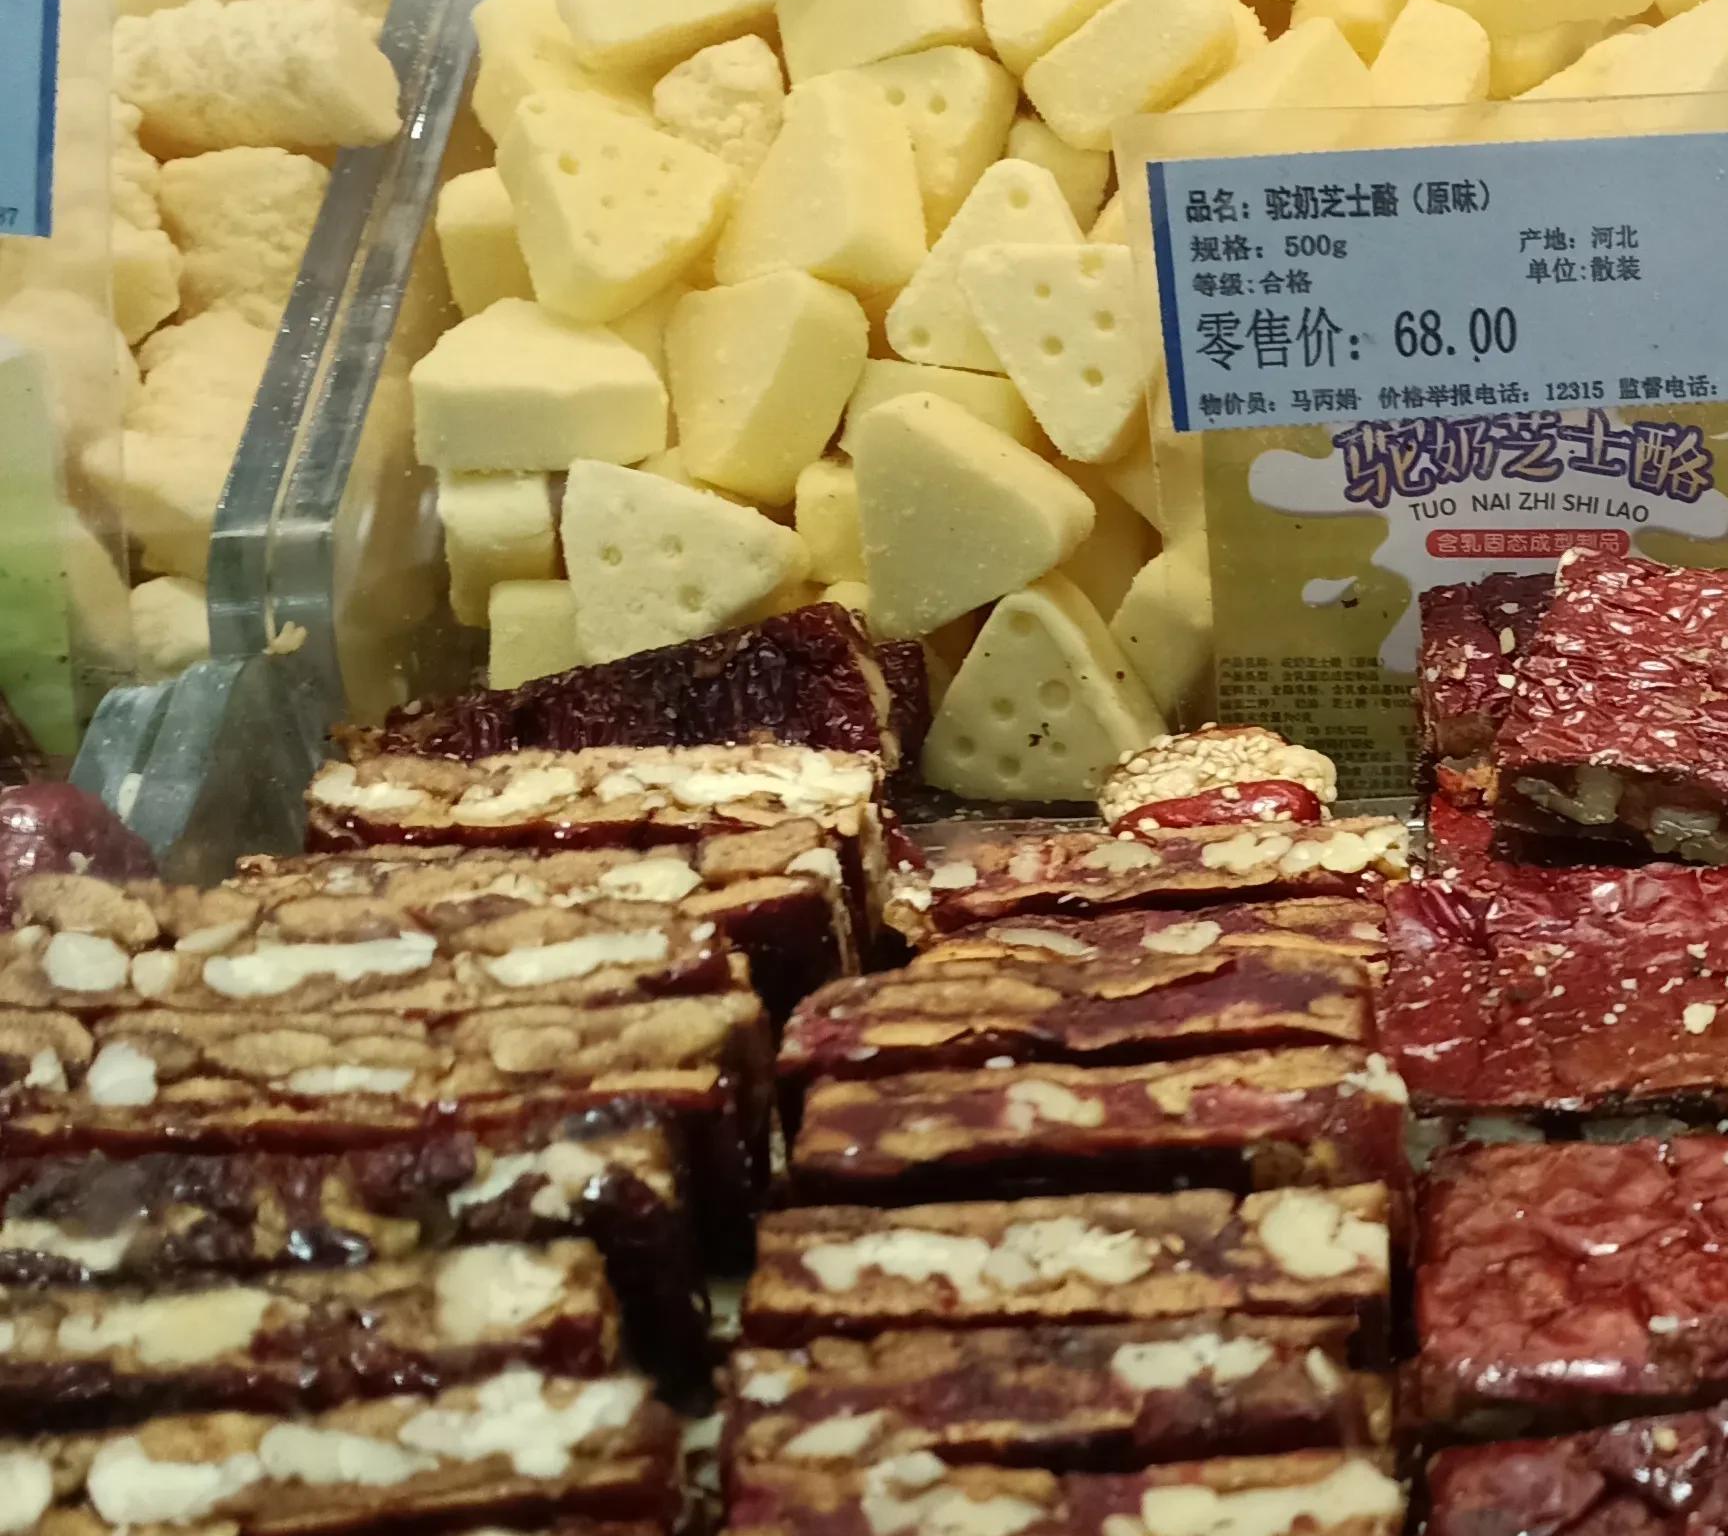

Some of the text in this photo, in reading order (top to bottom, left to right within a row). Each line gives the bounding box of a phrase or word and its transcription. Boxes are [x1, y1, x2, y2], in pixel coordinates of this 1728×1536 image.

[1333, 407, 1713, 509] 驼奶芝士酪
[1409, 492, 1650, 524] TUO NAI ZHI SHI LAO
[1436, 532, 1623, 555] 含乳固态成型制品
